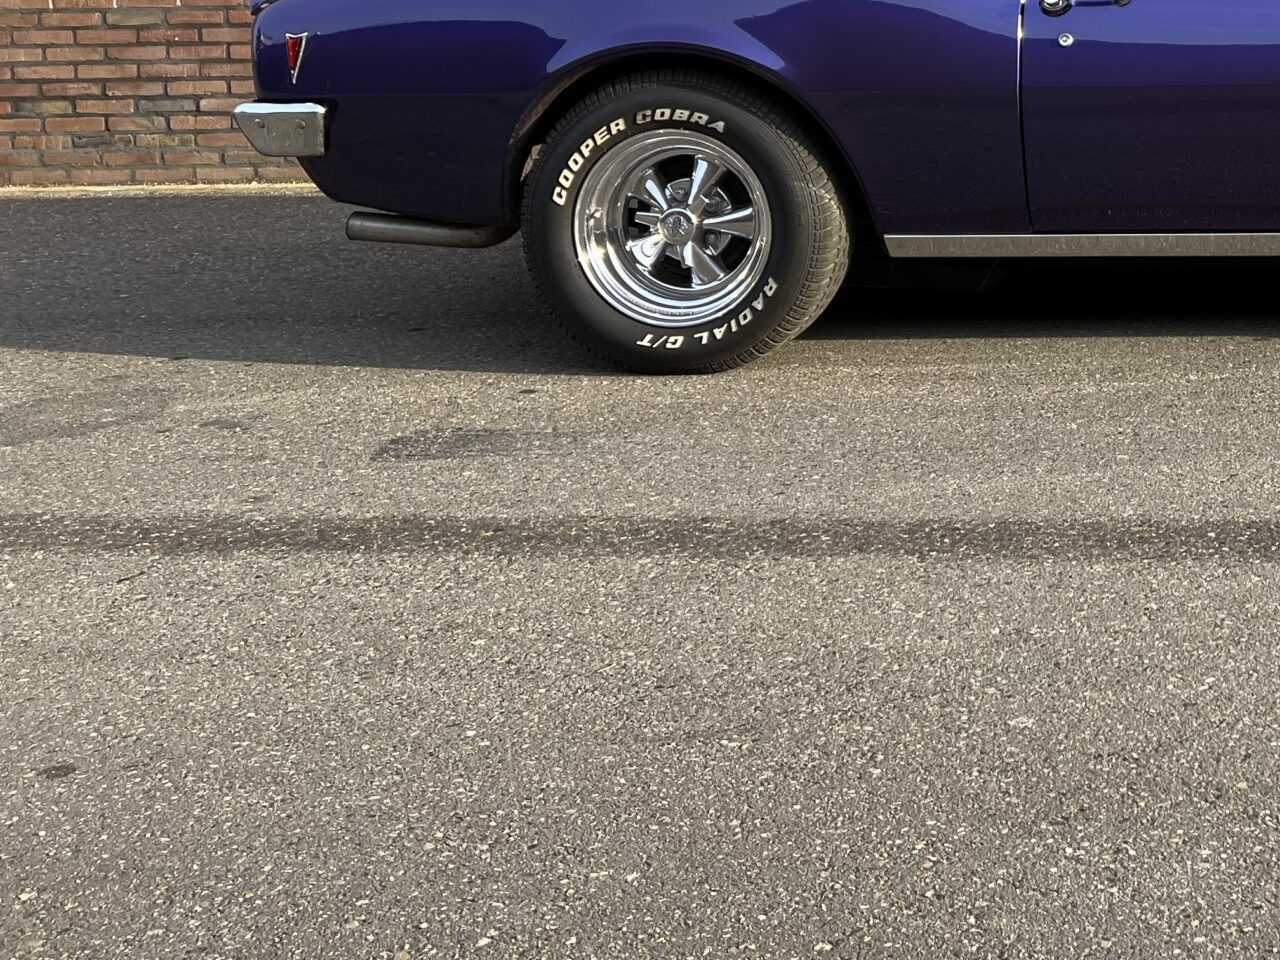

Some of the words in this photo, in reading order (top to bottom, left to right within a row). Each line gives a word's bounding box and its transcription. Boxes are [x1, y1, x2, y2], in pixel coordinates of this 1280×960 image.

[552, 117, 626, 206] COOPER
[636, 108, 726, 133] COBRA
[636, 333, 684, 349] G/T
[693, 277, 778, 345] RADIAL
